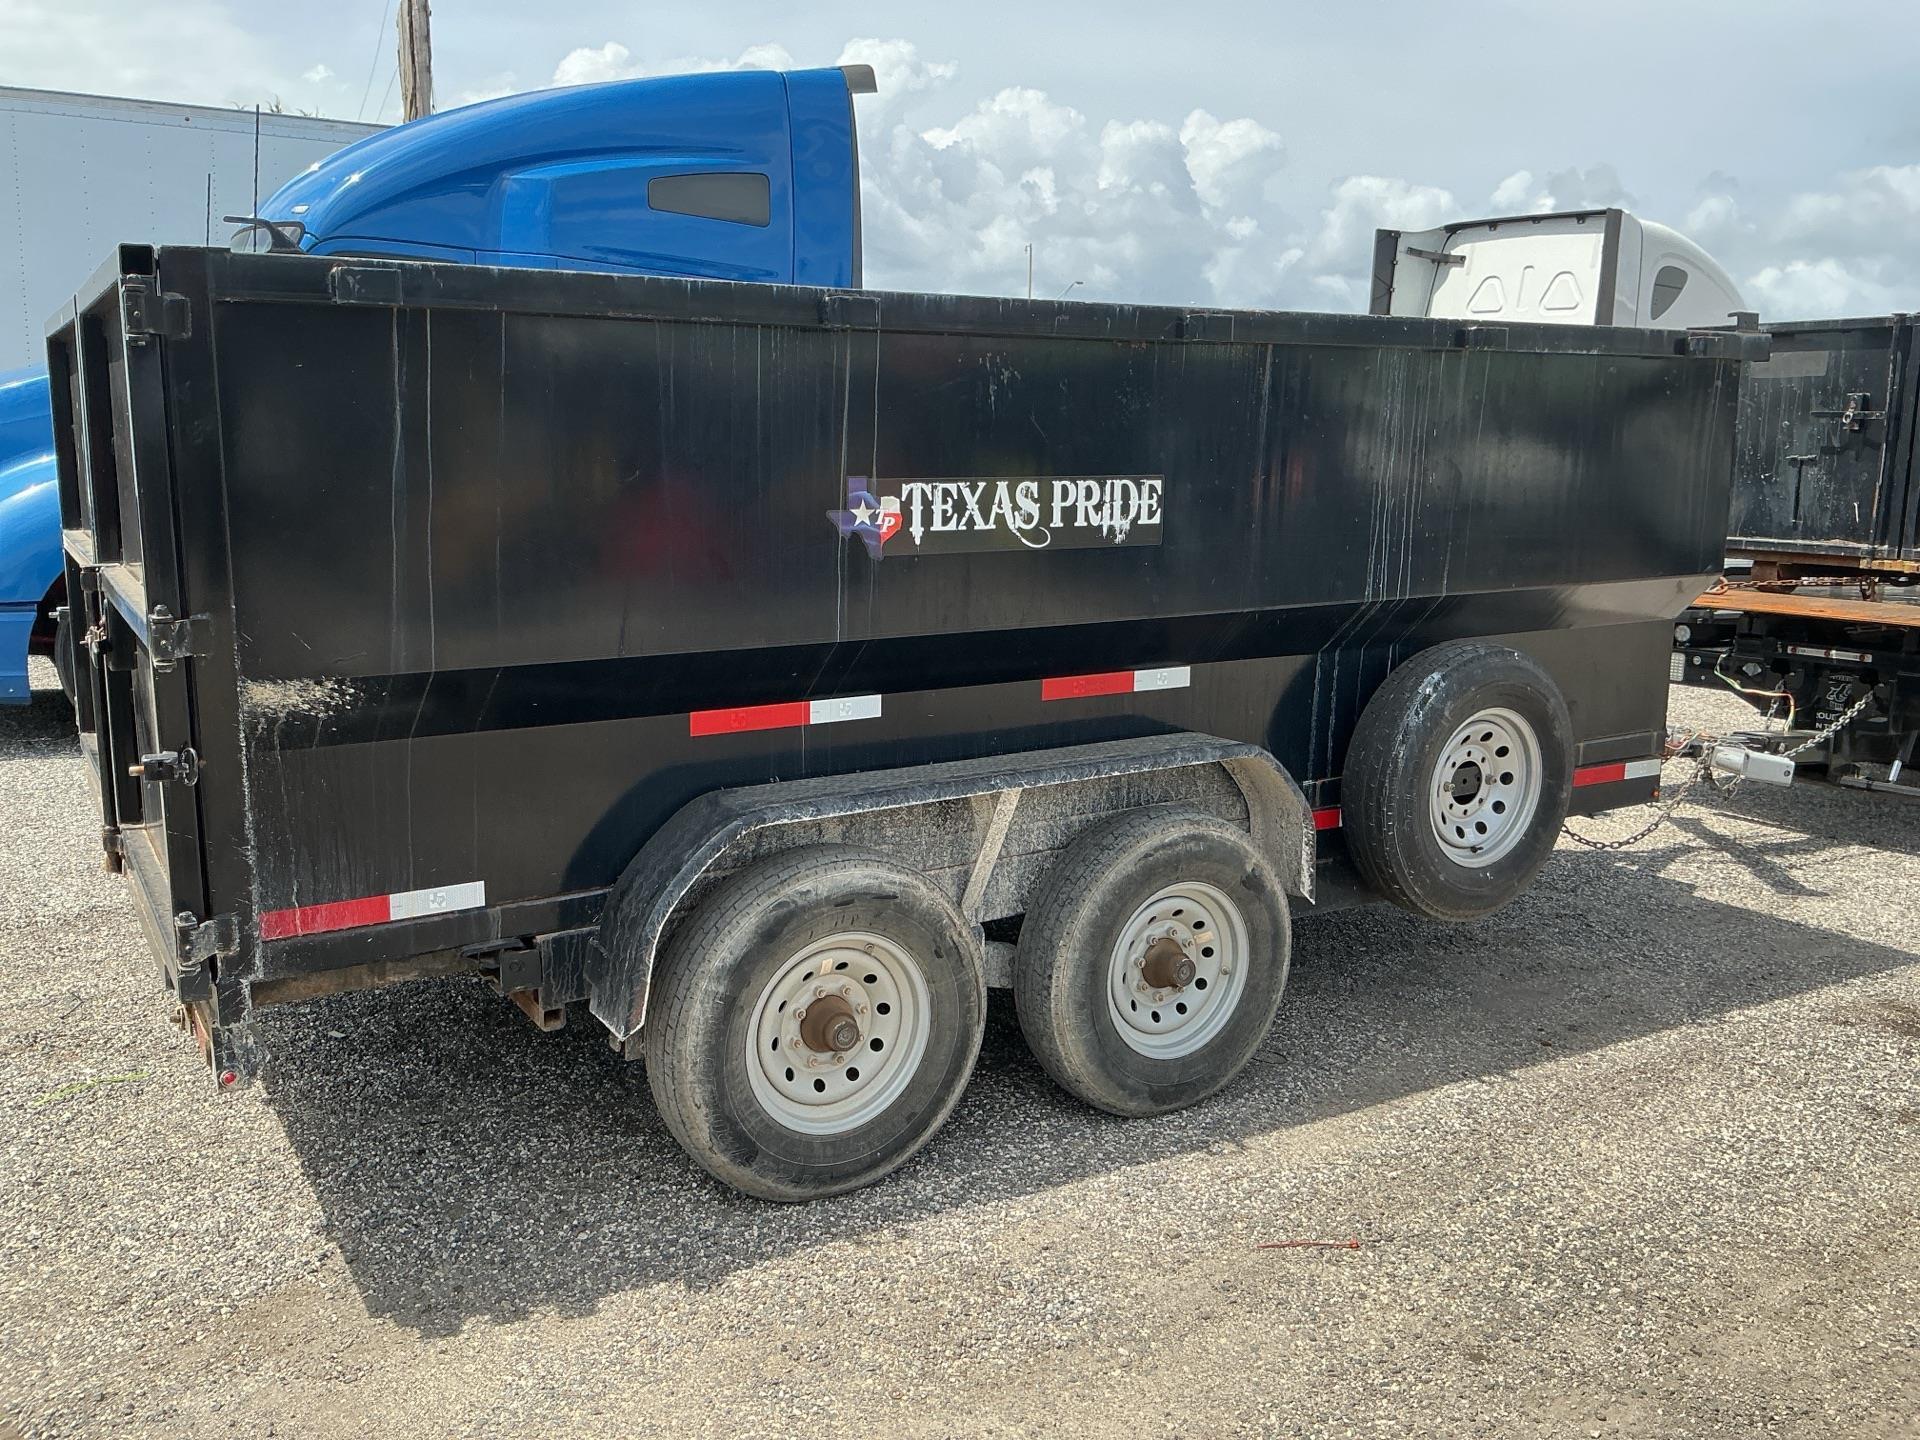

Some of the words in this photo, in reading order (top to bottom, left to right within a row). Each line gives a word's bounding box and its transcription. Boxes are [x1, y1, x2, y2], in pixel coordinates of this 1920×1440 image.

[875, 508, 896, 533] TP
[902, 480, 1050, 548] TEXAS
[1050, 479, 1162, 544] PRIDE
